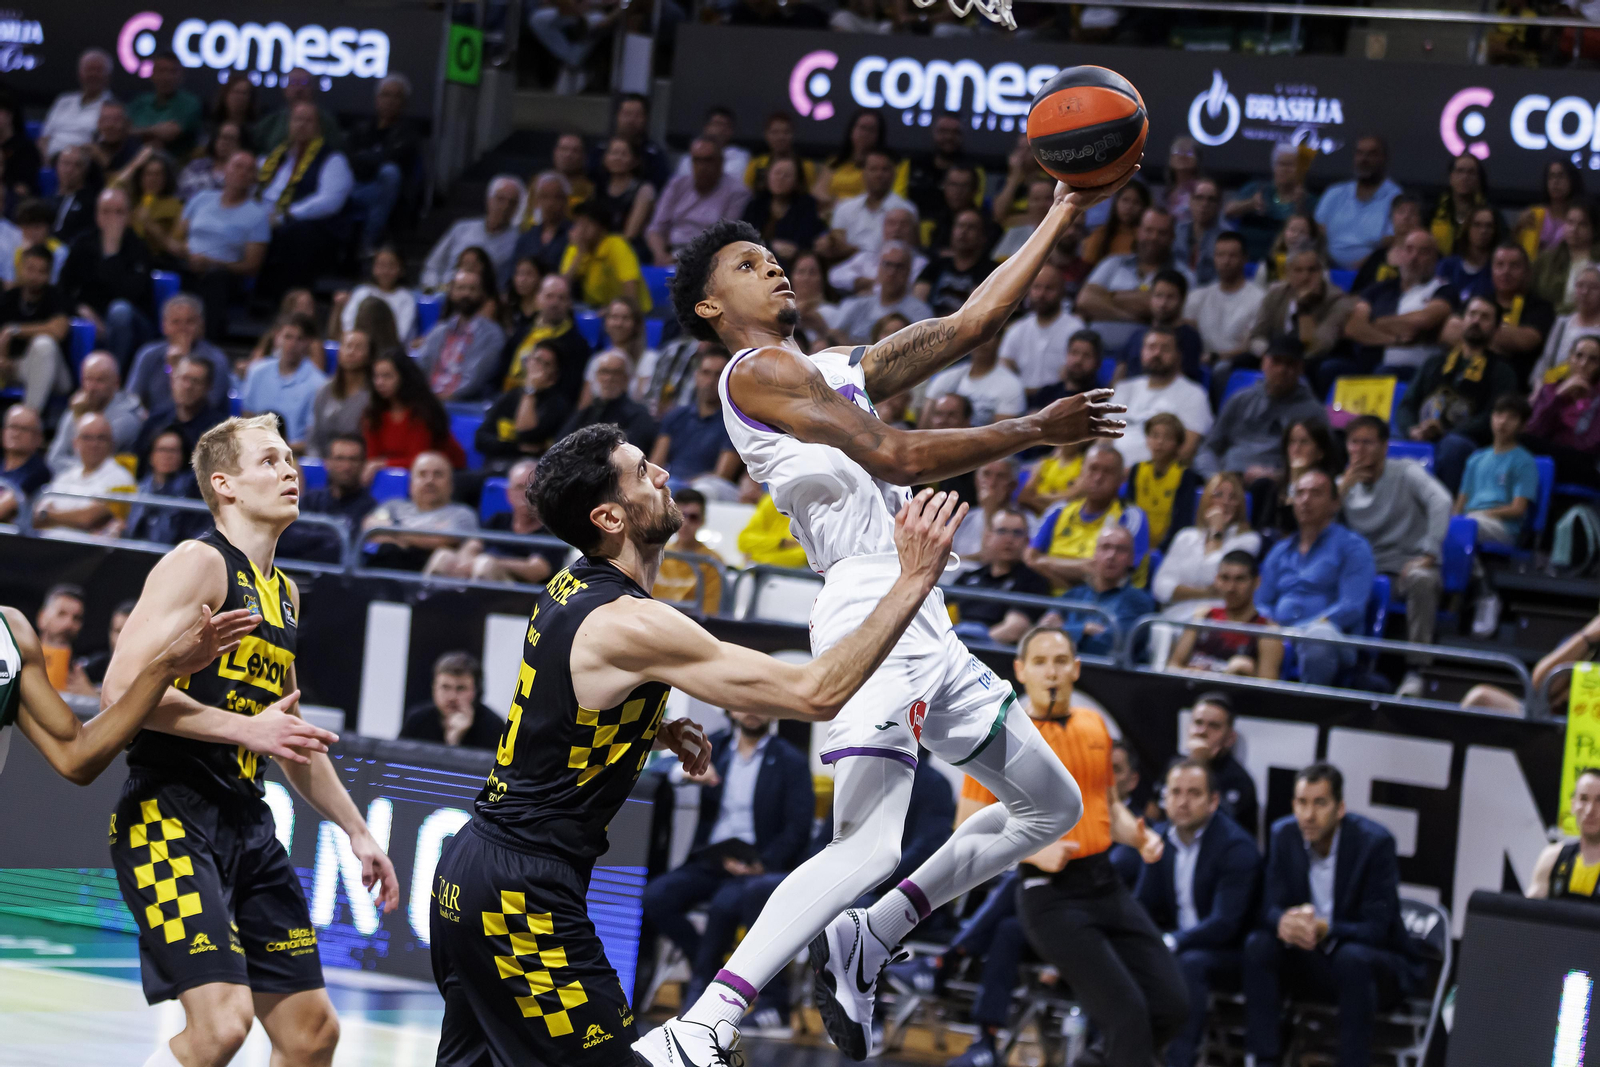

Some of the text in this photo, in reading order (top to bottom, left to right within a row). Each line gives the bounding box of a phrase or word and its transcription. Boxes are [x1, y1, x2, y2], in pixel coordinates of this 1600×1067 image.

[172, 18, 391, 79] comesa
[850, 55, 1070, 116] comes
[1509, 93, 1600, 152] co
[873, 322, 956, 378] Believe
[289, 928, 310, 939] Islas
